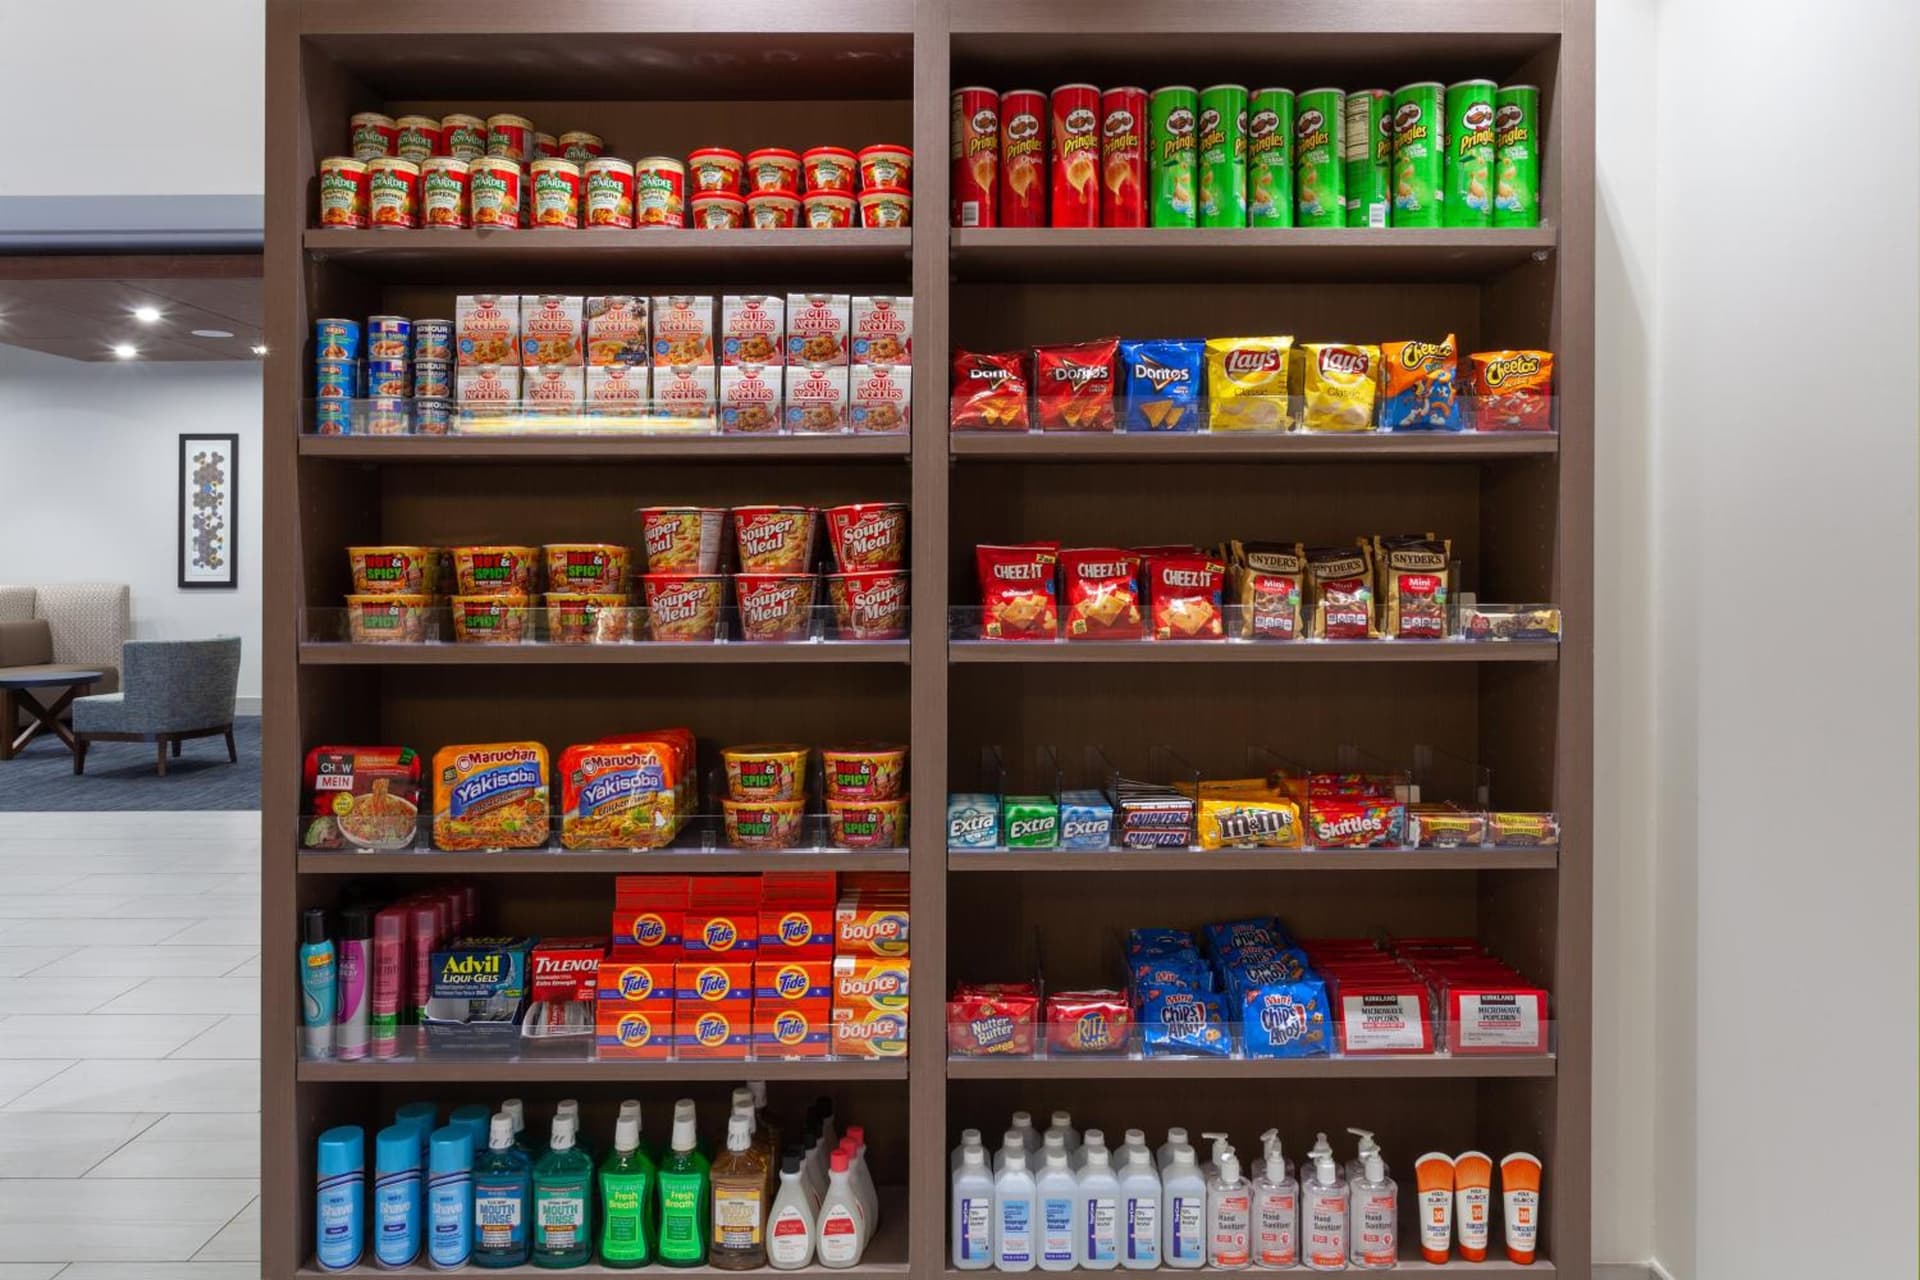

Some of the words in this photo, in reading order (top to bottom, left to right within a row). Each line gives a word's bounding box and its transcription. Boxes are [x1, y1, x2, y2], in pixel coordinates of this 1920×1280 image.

[1007, 137, 1041, 161] Pringles
[476, 310, 500, 321] CUP
[539, 310, 565, 321] CUP
[672, 310, 696, 320] CUP
[741, 310, 766, 321] CUP
[806, 309, 832, 320] CUP
[871, 311, 897, 321] CUP
[464, 320, 510, 332] NOODLES
[528, 320, 574, 332] NOODLES
[730, 319, 775, 332] NOODLES
[794, 319, 840, 331] NOODLES
[859, 320, 905, 332] NOODLES
[1228, 347, 1278, 372] Lay's
[1322, 347, 1367, 373] Lay's
[1055, 366, 1109, 381] Doritos
[1136, 364, 1190, 380] Doritos
[1486, 356, 1539, 386] Cheetos
[739, 379, 764, 390] CUP
[805, 379, 831, 390] CUP
[868, 379, 894, 390] CUP
[728, 389, 774, 401] NOODLES
[857, 388, 903, 401] NOODLES
[740, 518, 793, 545] Souper
[843, 515, 898, 545] Souper
[746, 536, 784, 557] Meal
[853, 533, 891, 557] Meal
[392, 559, 402, 567] &
[500, 559, 510, 567] &
[593, 556, 603, 565] &
[1251, 554, 1297, 568] SNYDER'S
[1393, 553, 1442, 565] SNYDER'S
[367, 568, 402, 580] SPICY
[475, 568, 510, 580] SPICY
[569, 566, 602, 577] SPICY
[1263, 579, 1285, 588] Mini
[1408, 578, 1431, 587] Mini
[652, 586, 706, 612] Souper
[744, 585, 797, 612] Souper
[854, 583, 905, 611] Souper
[389, 607, 399, 615] &
[490, 607, 500, 615] &
[659, 603, 697, 624] Meal
[750, 602, 789, 623] Meal
[865, 602, 900, 622] Meal
[466, 616, 499, 627] SPICY
[474, 748, 542, 766] Maruchan
[596, 755, 663, 768] Maruchan
[321, 763, 352, 773] CHW
[765, 765, 774, 774] &
[860, 765, 870, 774] &
[322, 776, 350, 786] MEIN
[743, 775, 774, 787] SPICY
[838, 775, 870, 786] SPICY
[462, 770, 541, 804] Yakisoba
[591, 775, 664, 806] Yakisoba
[761, 813, 771, 822] &
[867, 813, 877, 822] &
[1128, 812, 1188, 826] SNICKERS
[738, 823, 771, 835] SPICY
[844, 822, 876, 834] SPICY
[951, 814, 995, 837] Extra
[1010, 817, 1055, 839] Extra
[1063, 820, 1108, 839] Extra
[1319, 816, 1382, 840] Skittles
[1127, 832, 1185, 846] SNICKERS
[636, 921, 664, 940] Tide
[707, 925, 734, 945] Tide
[782, 920, 809, 939] Tide
[841, 920, 897, 940] bounce
[442, 955, 500, 974] Advil
[536, 957, 598, 973] TYLENOL
[442, 973, 499, 984] LIQUI-GELS
[622, 975, 650, 994] Tide
[699, 974, 727, 995] Tide
[779, 973, 806, 993] Tide
[839, 976, 897, 995] bounce
[1165, 994, 1193, 1004] Mini
[1265, 994, 1292, 1005] Mini
[1361, 1007, 1404, 1015] MICROWAVE
[621, 1021, 648, 1041] Tide
[698, 1020, 726, 1040] Tide
[777, 1019, 805, 1039] Tide
[839, 1019, 896, 1038] bounce
[972, 1016, 1009, 1035] Nutter
[1077, 1016, 1105, 1042] RITZ
[978, 1024, 1015, 1045] Butter
[614, 1192, 638, 1201] Fresh
[670, 1192, 695, 1201] Fresh
[480, 1204, 515, 1214] MOUTH
[543, 1204, 578, 1214] MOUTH
[609, 1200, 638, 1209] Breath
[665, 1200, 694, 1209] Breath
[482, 1214, 512, 1224] RINSE
[545, 1214, 575, 1224] RINSE
[1218, 1214, 1236, 1222] Hand
[1263, 1213, 1280, 1221] Hand
[1314, 1214, 1331, 1222] Hand
[1365, 1213, 1382, 1221] Hand
[1219, 1222, 1246, 1230] Sanitizer
[1263, 1221, 1291, 1229] Sanitizer
[1314, 1222, 1342, 1231] Sanitizer
[1365, 1221, 1392, 1229] Sanitizer
